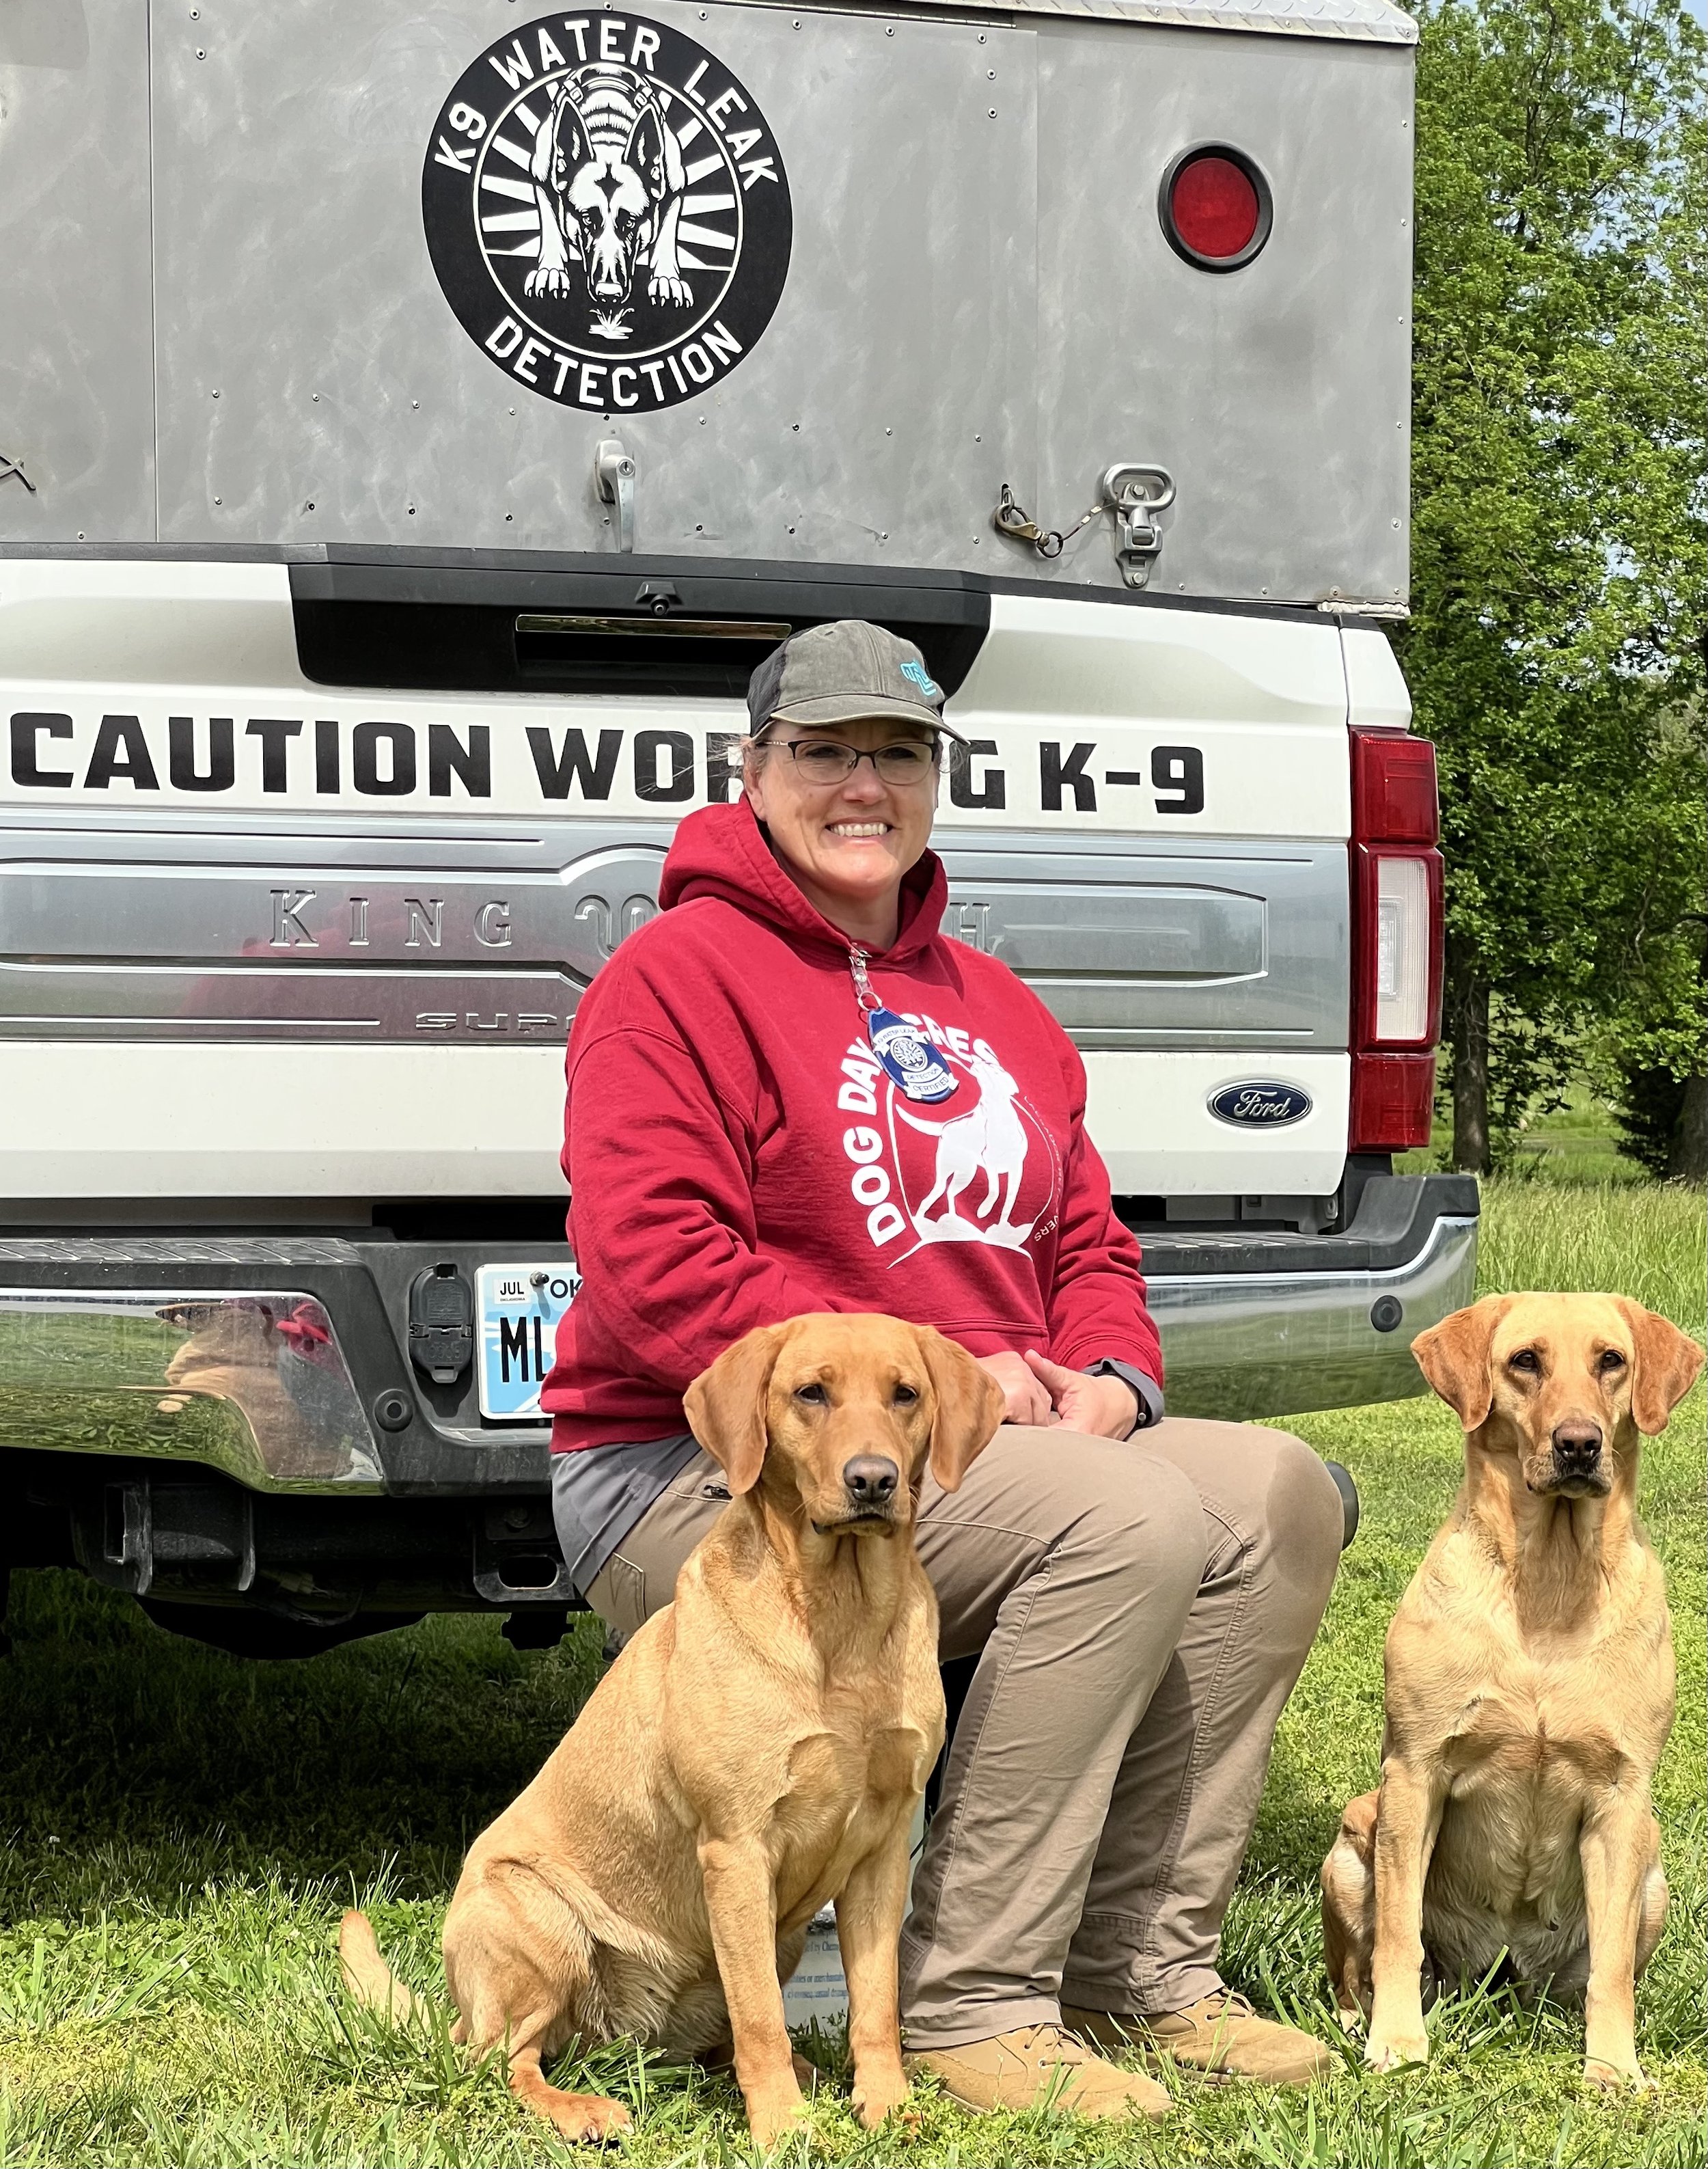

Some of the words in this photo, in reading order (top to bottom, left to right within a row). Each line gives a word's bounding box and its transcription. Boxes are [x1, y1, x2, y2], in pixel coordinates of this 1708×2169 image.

[434, 102, 487, 174] K9
[488, 20, 661, 90] WATER
[683, 59, 779, 191] LEAK
[484, 315, 743, 407] DETECTION
[10, 712, 491, 798] CAUTION
[525, 726, 1006, 810] WORG
[1040, 741, 1204, 814] K-9
[269, 889, 512, 947] KING
[415, 1013, 576, 1031] SUP
[898, 1013, 1002, 1067] CRES
[837, 1036, 883, 1116] DAY
[907, 1067, 939, 1080] DETECTION
[912, 1076, 950, 1092] CERTIFIED
[1234, 1089, 1291, 1118] Ford
[843, 1126, 907, 1247] DOG
[500, 1281, 524, 1296] JUL
[550, 1279, 583, 1298] OK
[500, 1316, 547, 1382] ML
